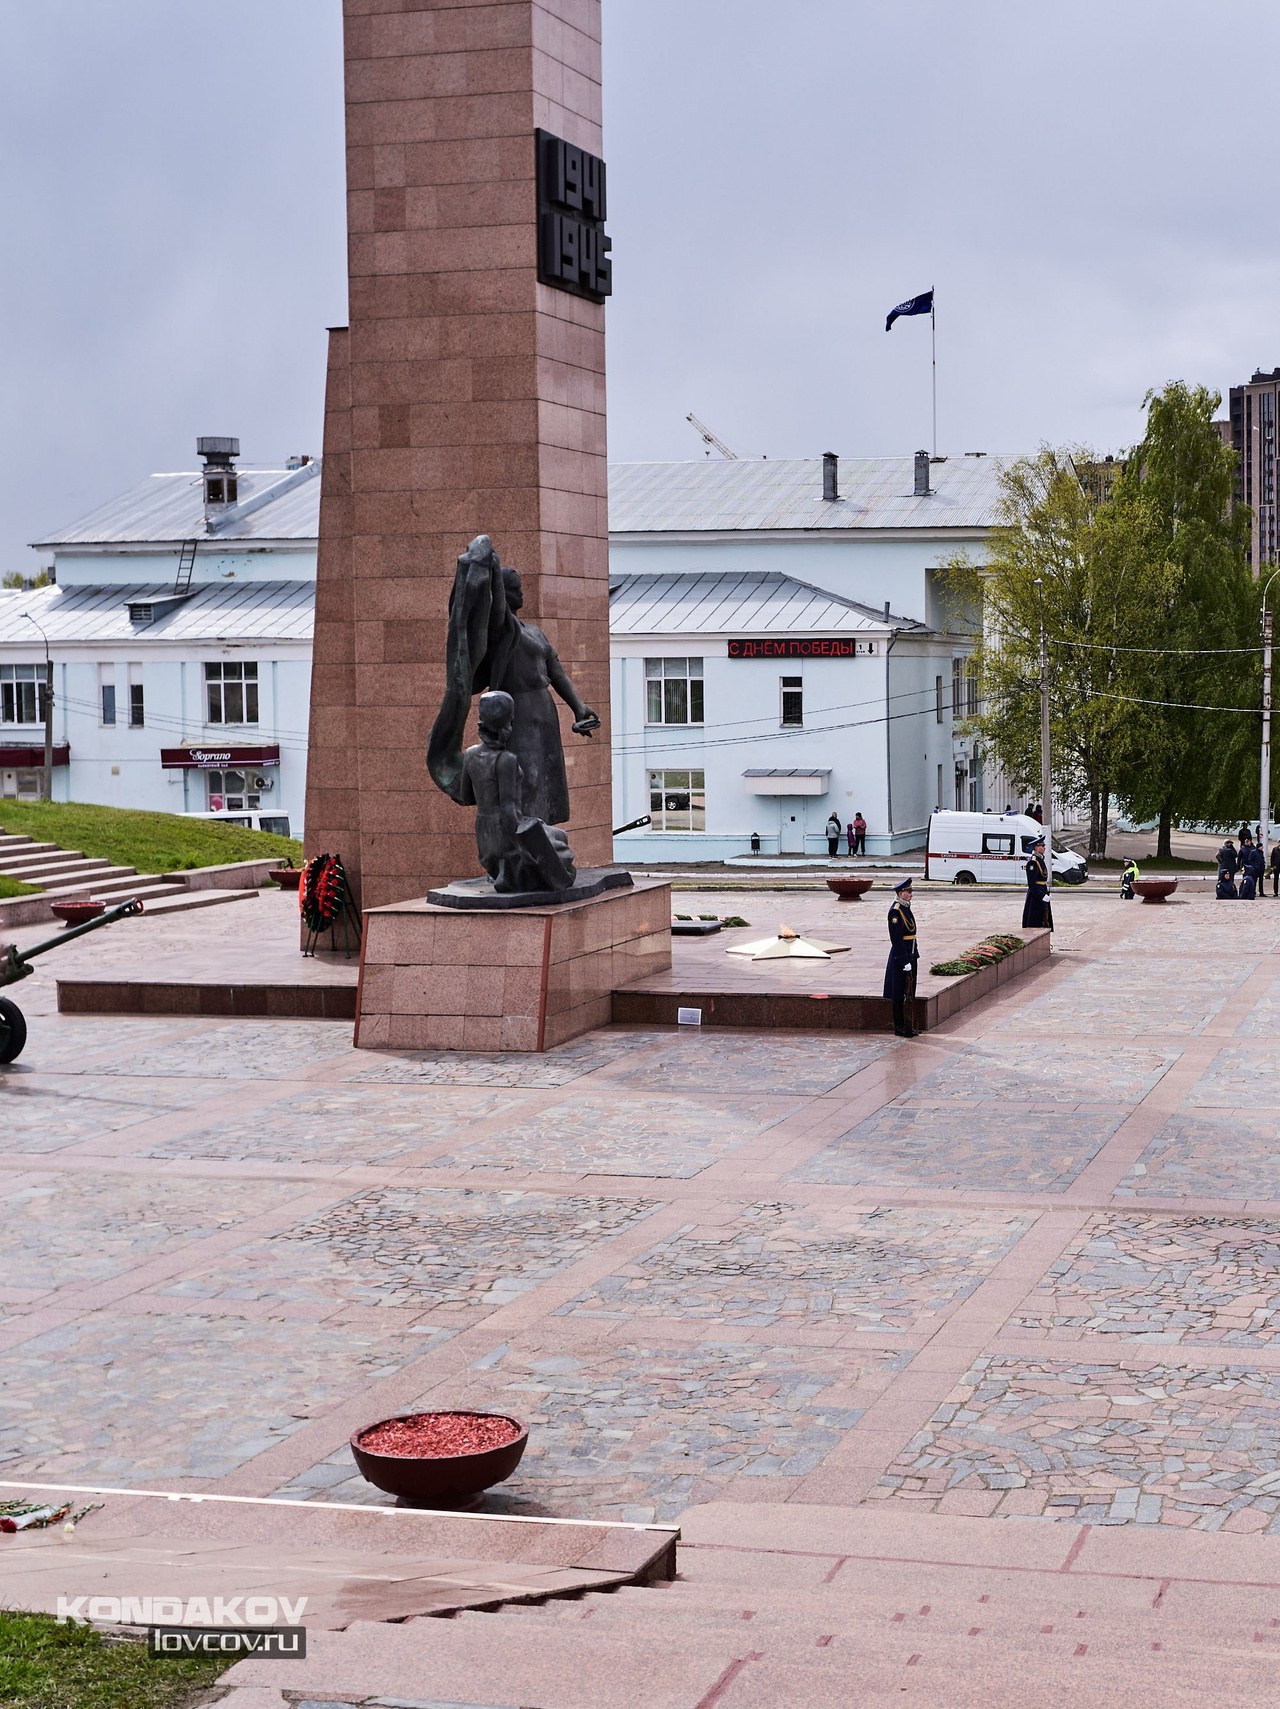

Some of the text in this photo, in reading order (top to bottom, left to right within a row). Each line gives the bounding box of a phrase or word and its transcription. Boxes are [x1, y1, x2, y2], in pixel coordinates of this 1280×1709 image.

[551, 138, 607, 221] 1941
[547, 213, 612, 296] 1945
[729, 640, 853, 657] С ДНЁМ ПОБЕДЫ
[189, 749, 231, 762] Soprano
